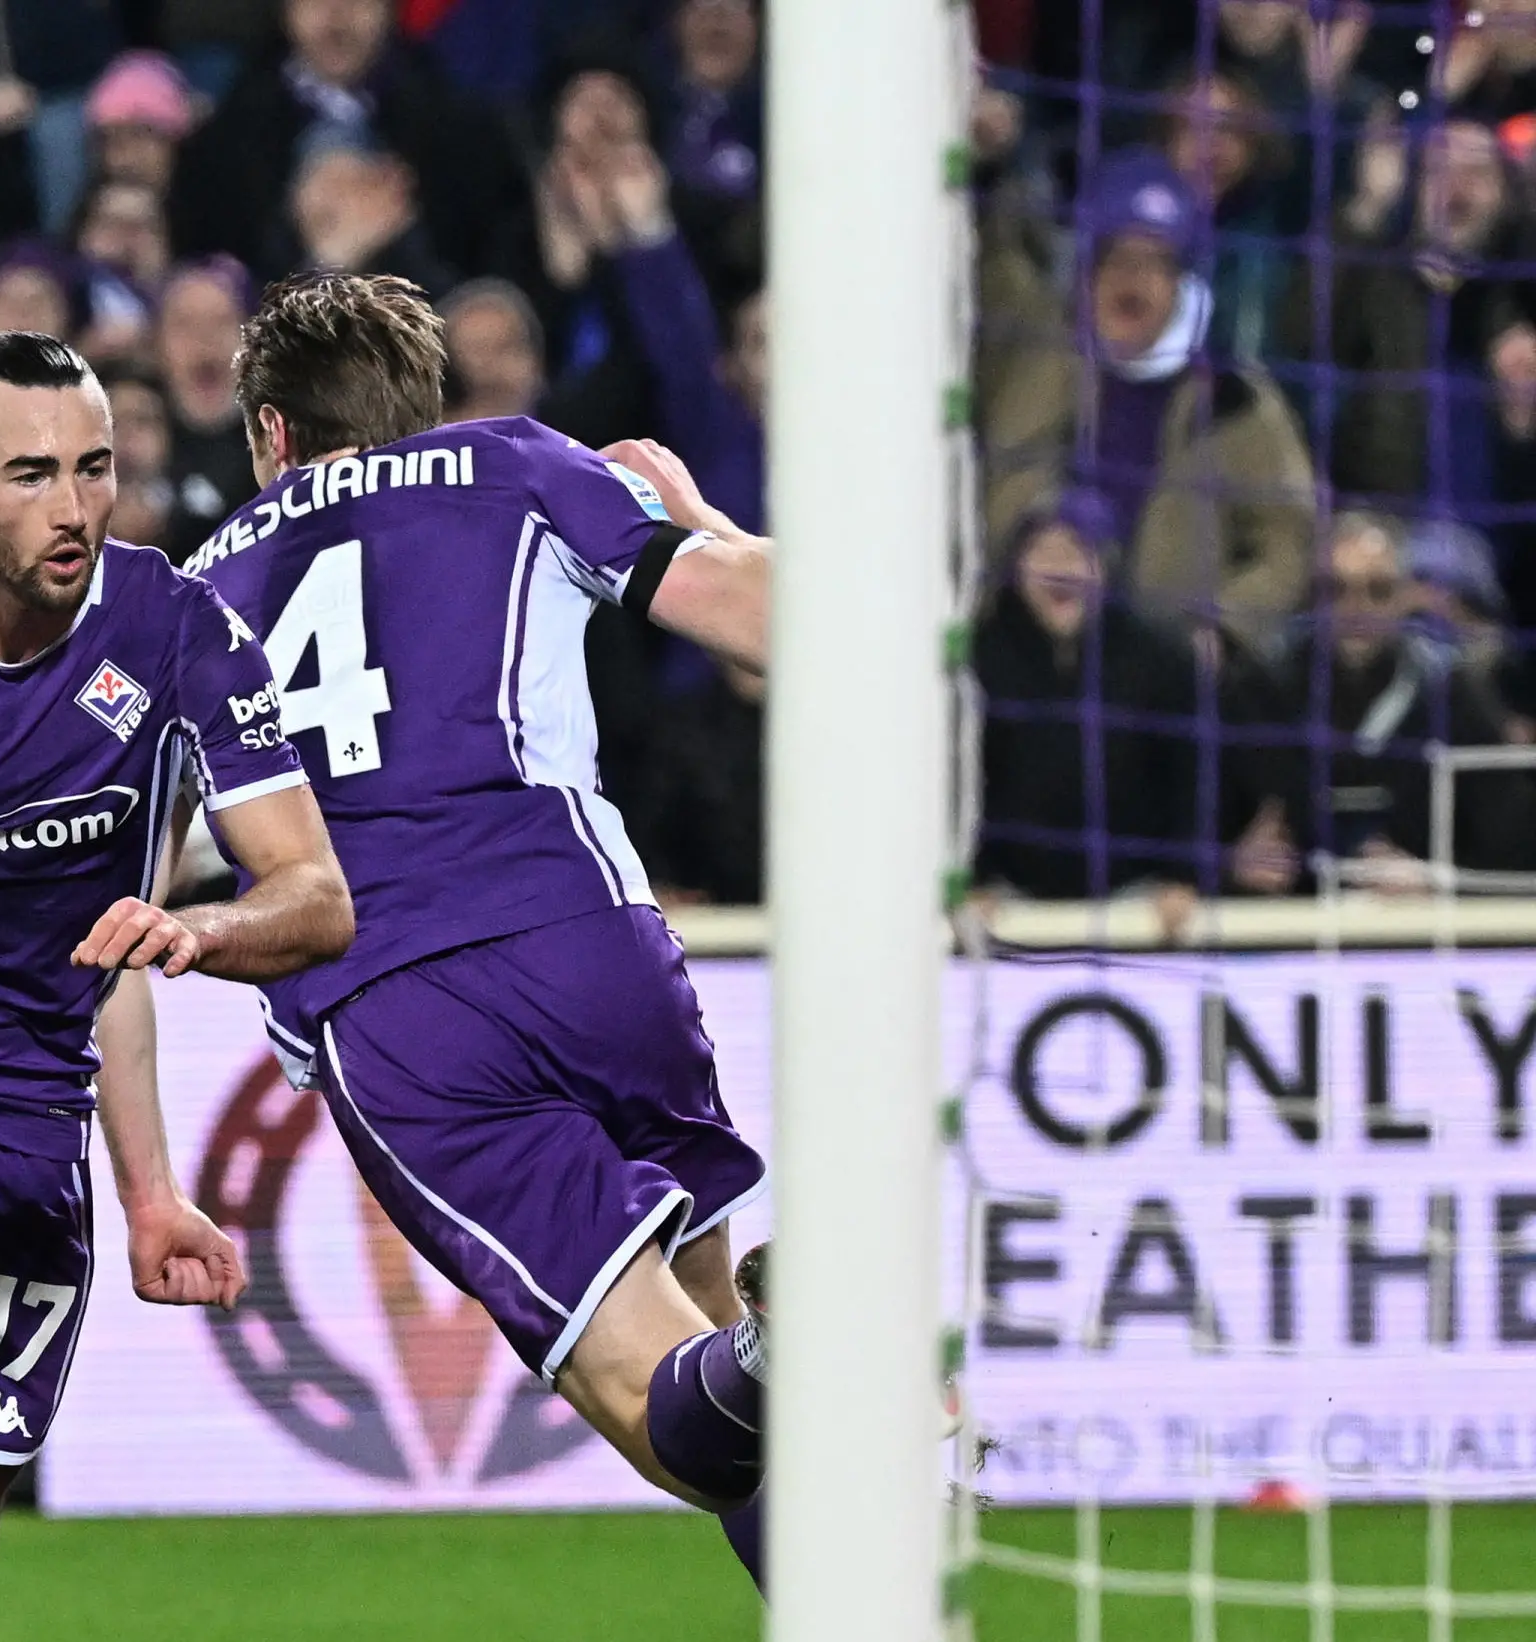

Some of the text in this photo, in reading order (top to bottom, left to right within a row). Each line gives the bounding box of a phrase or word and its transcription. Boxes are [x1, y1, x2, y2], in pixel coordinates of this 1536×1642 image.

[182, 446, 474, 577] BRESCIANINI
[264, 540, 392, 779] 4
[1014, 990, 1536, 1148] ONLY
[981, 1195, 1536, 1350] EATHE
